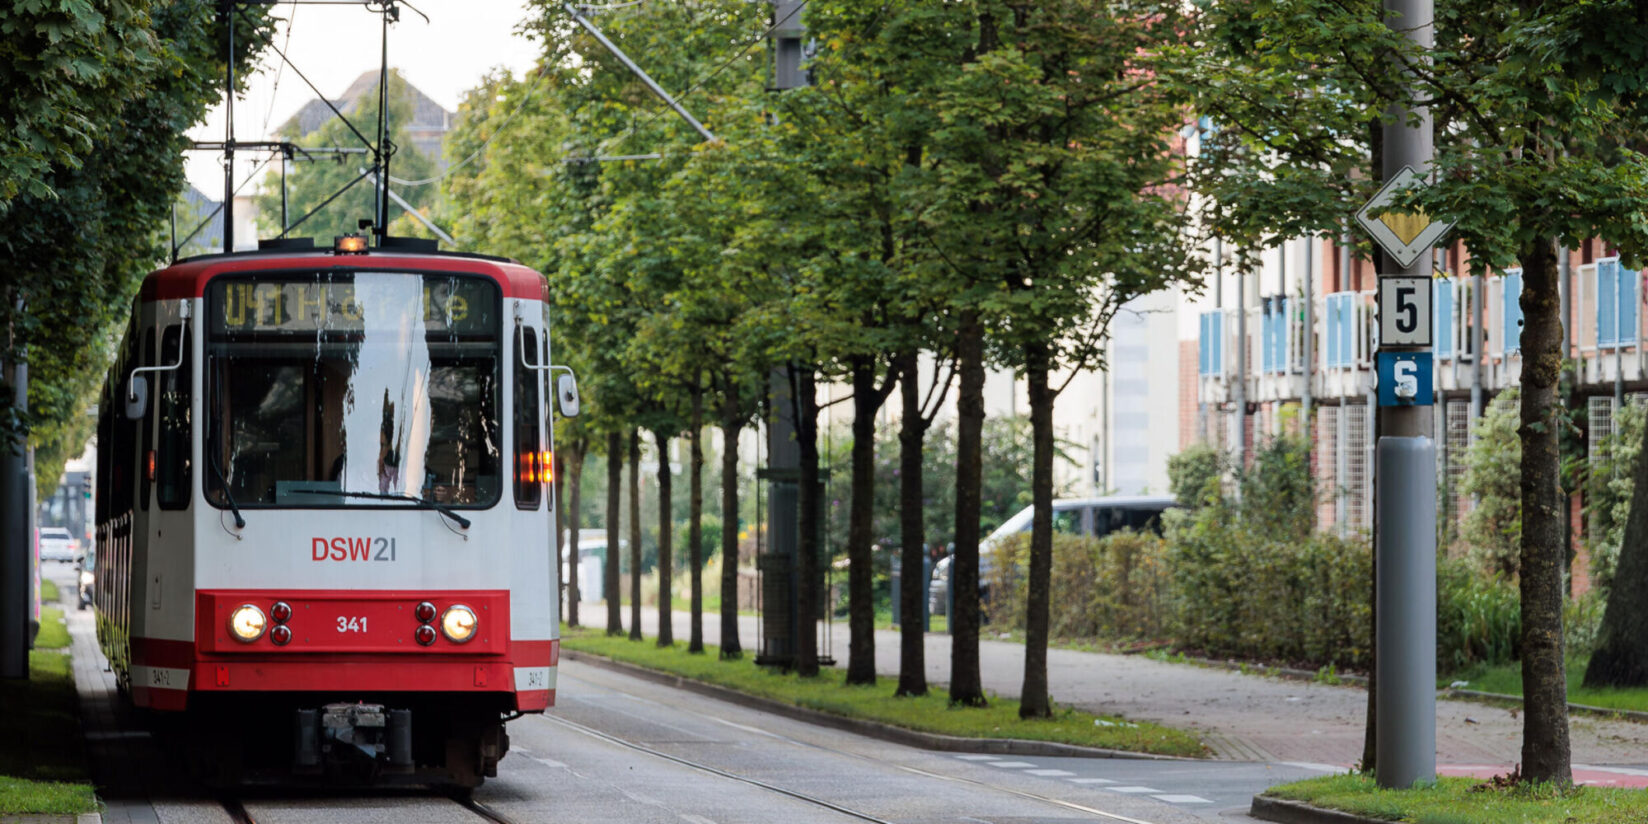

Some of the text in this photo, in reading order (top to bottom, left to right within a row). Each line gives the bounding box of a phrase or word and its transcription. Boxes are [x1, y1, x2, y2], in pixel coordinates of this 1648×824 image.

[226, 284, 282, 326] U41
[1395, 286, 1418, 334] 5
[1393, 359, 1418, 397] S
[311, 536, 396, 562] DSW21
[336, 615, 368, 633] 341
